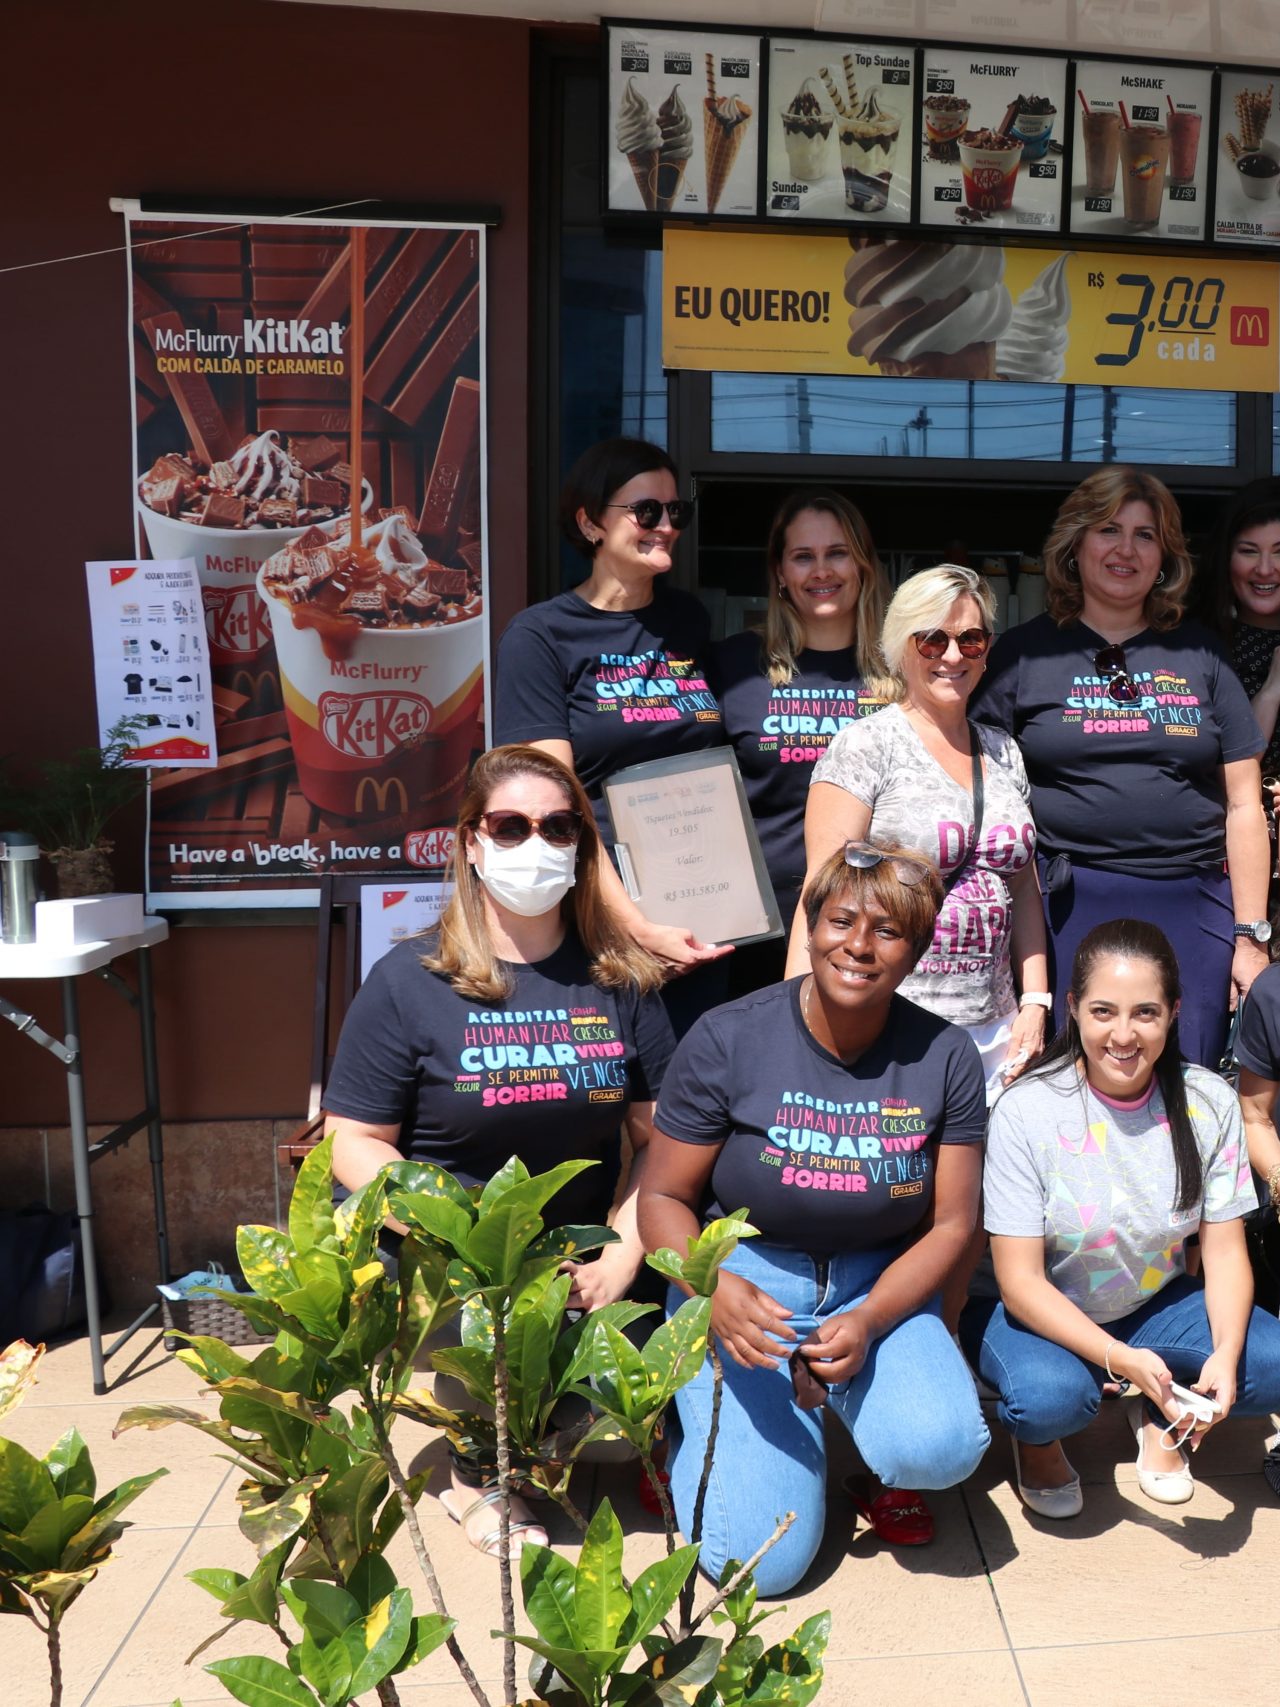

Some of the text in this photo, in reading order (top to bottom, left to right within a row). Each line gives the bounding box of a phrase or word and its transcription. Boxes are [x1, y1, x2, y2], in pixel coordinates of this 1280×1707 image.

[855, 53, 910, 68] Top Sundae
[970, 64, 1018, 77] McFLURRY
[1121, 76, 1163, 90] McSHAKE
[772, 181, 808, 193] Sundae
[1236, 222, 1254, 230] EXTRA
[1088, 272, 1104, 289] R$
[675, 286, 830, 326] EU QUERO!
[156, 318, 344, 359] McFlurry KitKat
[1158, 337, 1216, 362] cada
[157, 357, 344, 376] COM CALDA DE CARAMELO
[206, 554, 262, 573] McFlu
[330, 660, 422, 683] McFlurry
[596, 677, 679, 698] CURAR
[772, 689, 855, 699] ACREDITAR
[1156, 682, 1191, 695] CRESCER
[622, 697, 632, 707] SE
[768, 700, 855, 716] HUMANIZAR
[1156, 695, 1199, 705] VIVER
[622, 707, 681, 723] SORRIR
[1103, 710, 1142, 718] PERMITIR
[1147, 707, 1202, 725] VENCER
[336, 698, 422, 758] KitKat
[1083, 719, 1150, 734] SORRIR
[1168, 727, 1195, 735] GRAACC
[784, 736, 831, 746] SE PERMIT
[668, 824, 698, 837] 19.505
[169, 843, 226, 863] Have
[232, 849, 245, 862] a
[254, 838, 326, 865] break,
[331, 840, 381, 859] have
[388, 846, 400, 859] a
[676, 855, 703, 866] Valor:
[680, 882, 729, 898] 331.585,00
[958, 960, 988, 974] NOT
[468, 1009, 568, 1024] ACREDITAR
[465, 1024, 572, 1046] HUMANIZAR
[574, 1026, 616, 1041] CRESCER
[460, 1042, 624, 1072] CURAR VIVER
[488, 1068, 559, 1085] SE PERMITIR
[454, 1082, 480, 1092] SEGUIR
[482, 1082, 567, 1107] SORRIR
[592, 1091, 622, 1101] GRAACC
[782, 1092, 879, 1114] ACREDITAR
[776, 1107, 880, 1135] HUMANIZAR
[882, 1118, 926, 1134] CRESCER
[768, 1126, 882, 1158] CURAR
[759, 1152, 781, 1167] SEGUIR
[789, 1152, 861, 1172] SE PERMITIR
[781, 1166, 868, 1193] SORRIR
[894, 1185, 920, 1196] GRAACC
